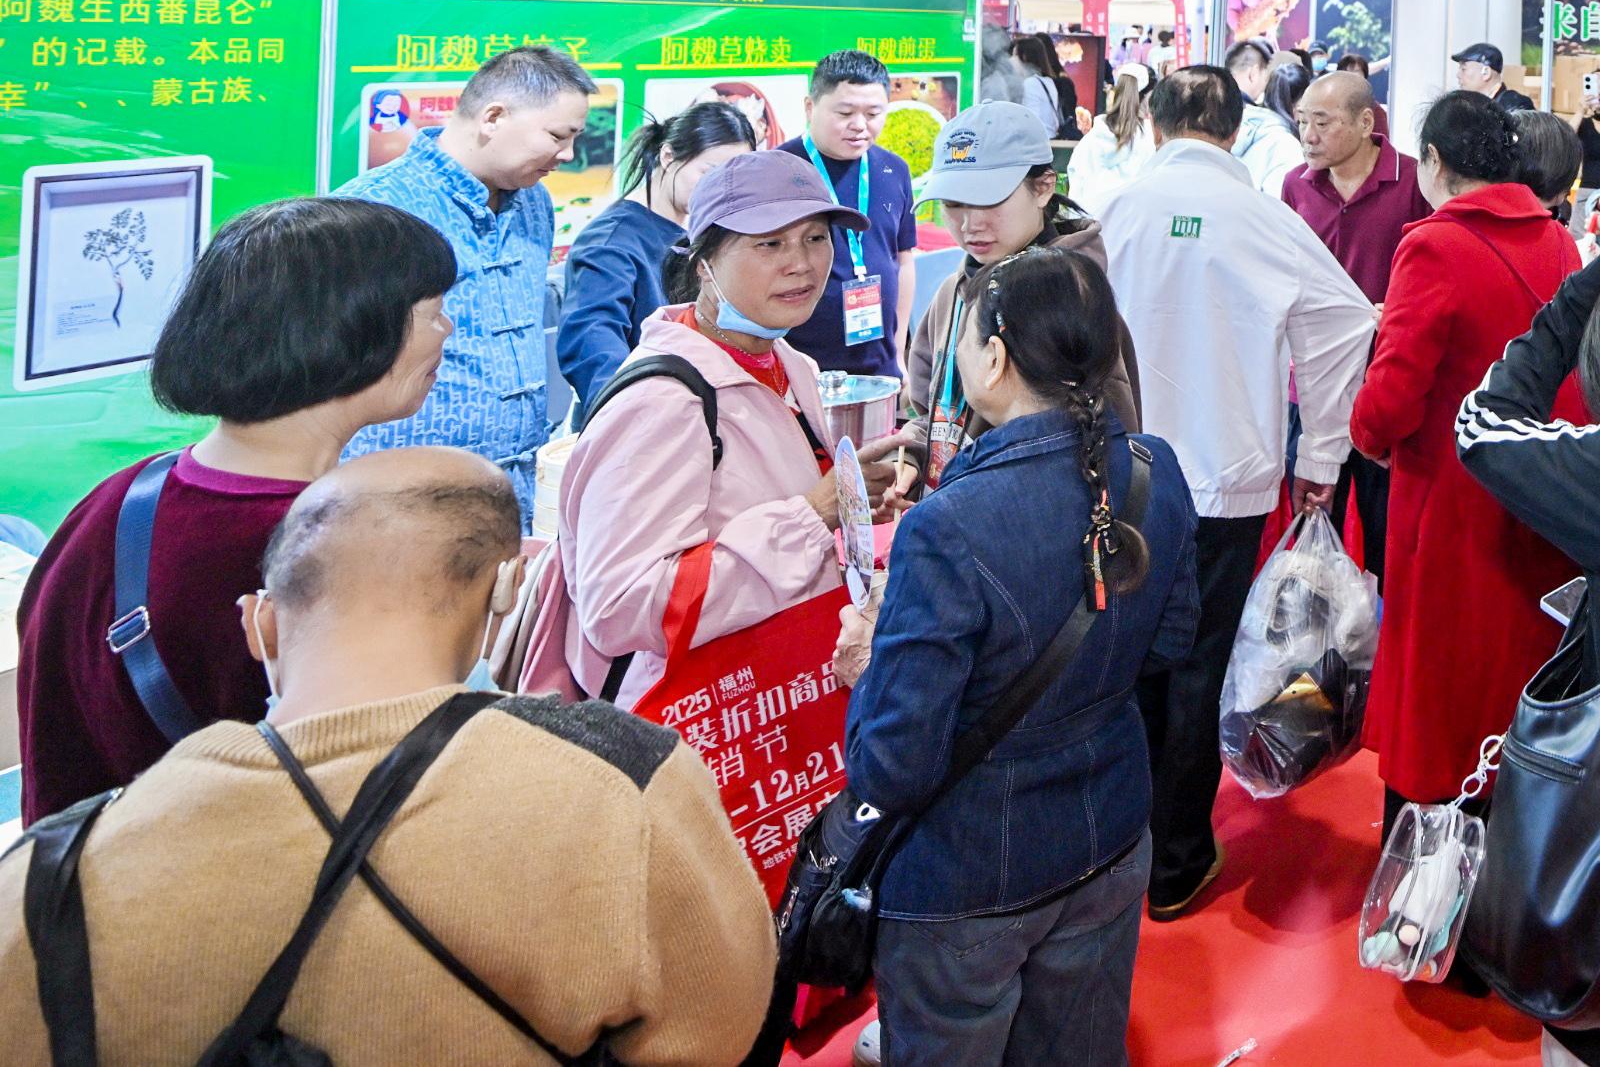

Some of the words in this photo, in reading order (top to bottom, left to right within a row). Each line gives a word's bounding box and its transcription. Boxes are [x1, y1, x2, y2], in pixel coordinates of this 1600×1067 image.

[660, 35, 792, 66] 阿魏草烧卖
[718, 665, 755, 693] 福州
[721, 681, 757, 702] FUZHOU
